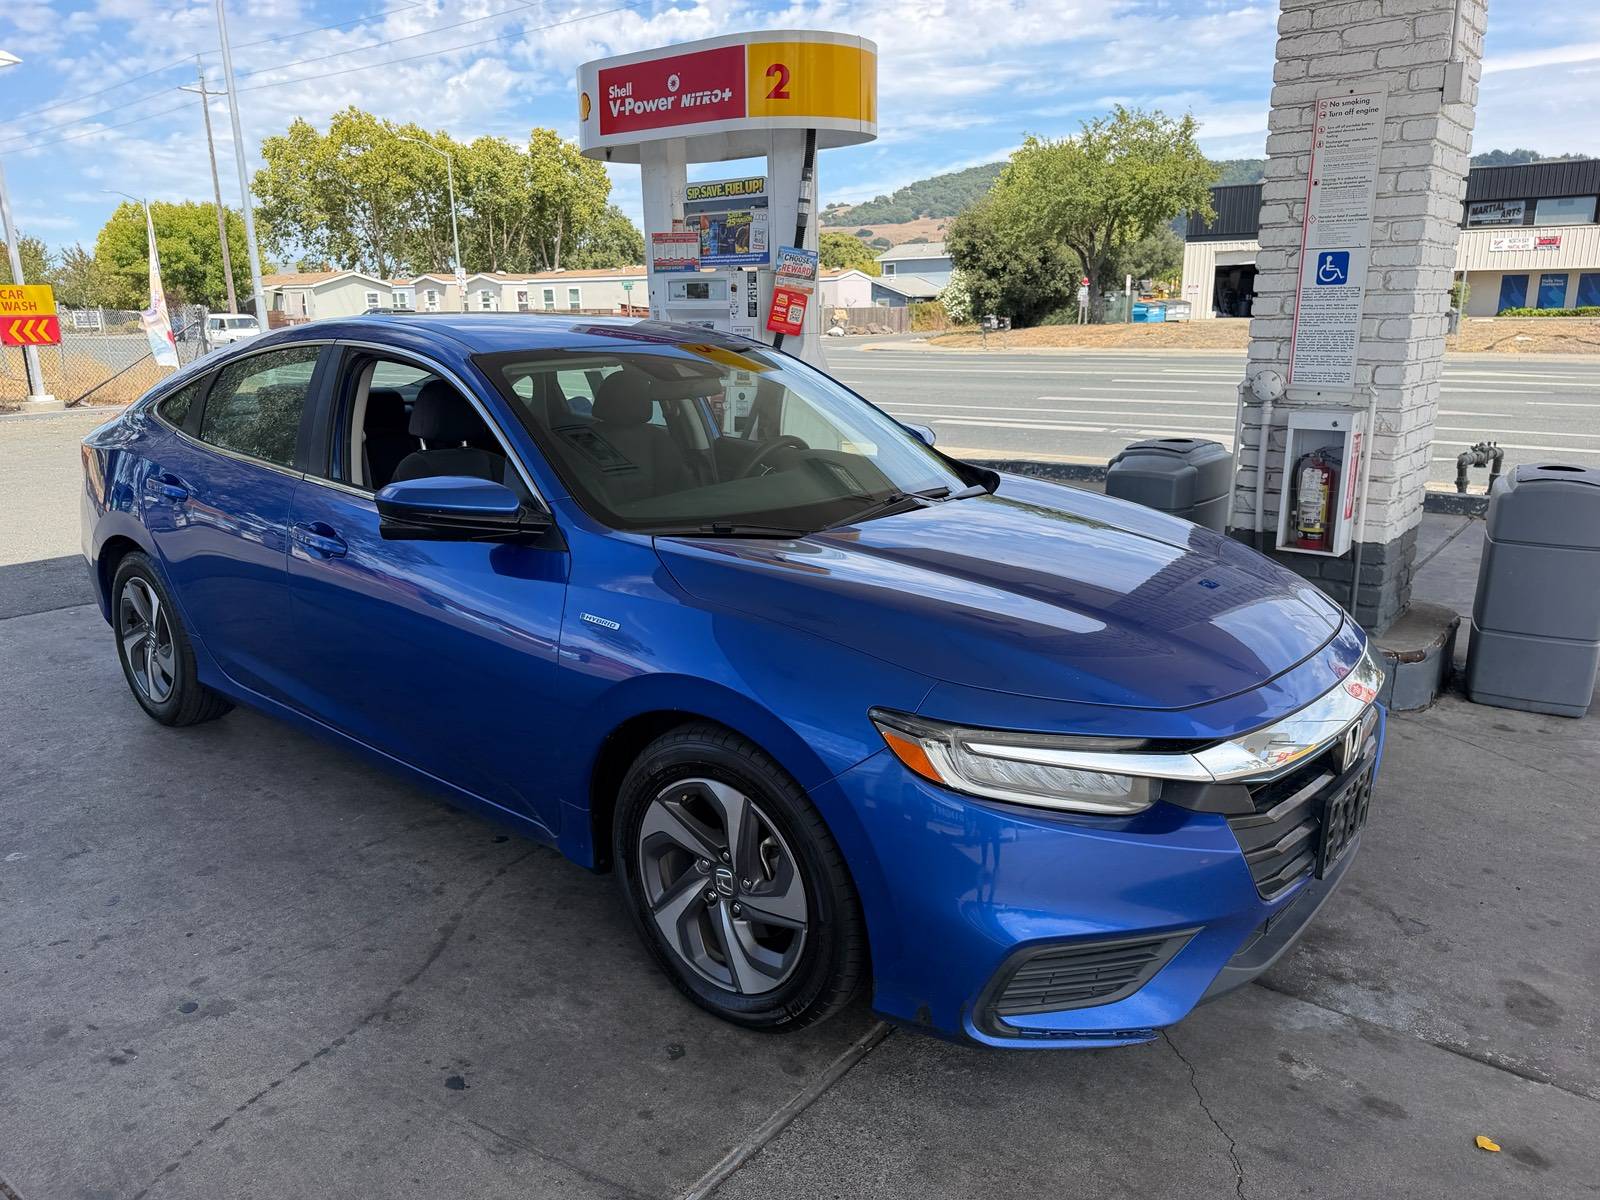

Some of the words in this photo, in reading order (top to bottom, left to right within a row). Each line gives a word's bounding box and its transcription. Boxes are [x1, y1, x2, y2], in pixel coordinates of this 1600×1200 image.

[765, 63, 790, 100] 2
[608, 81, 632, 98] Shell
[608, 96, 675, 117] V-Power
[1341, 97, 1371, 106] smoking
[1344, 107, 1355, 115] off
[1355, 106, 1380, 115] engine
[686, 185, 701, 200] SIP.
[700, 183, 725, 198] SAVE.
[725, 180, 744, 196] FUEL
[744, 177, 764, 194] UP!
[1472, 203, 1505, 216] MARTIAL
[1501, 208, 1522, 218] ARTS
[784, 253, 810, 265] CHOOSE
[781, 263, 813, 277] REWARD
[0, 289, 24, 299] CAR
[1, 301, 37, 311] WASH
[584, 614, 617, 629] HYBRID
